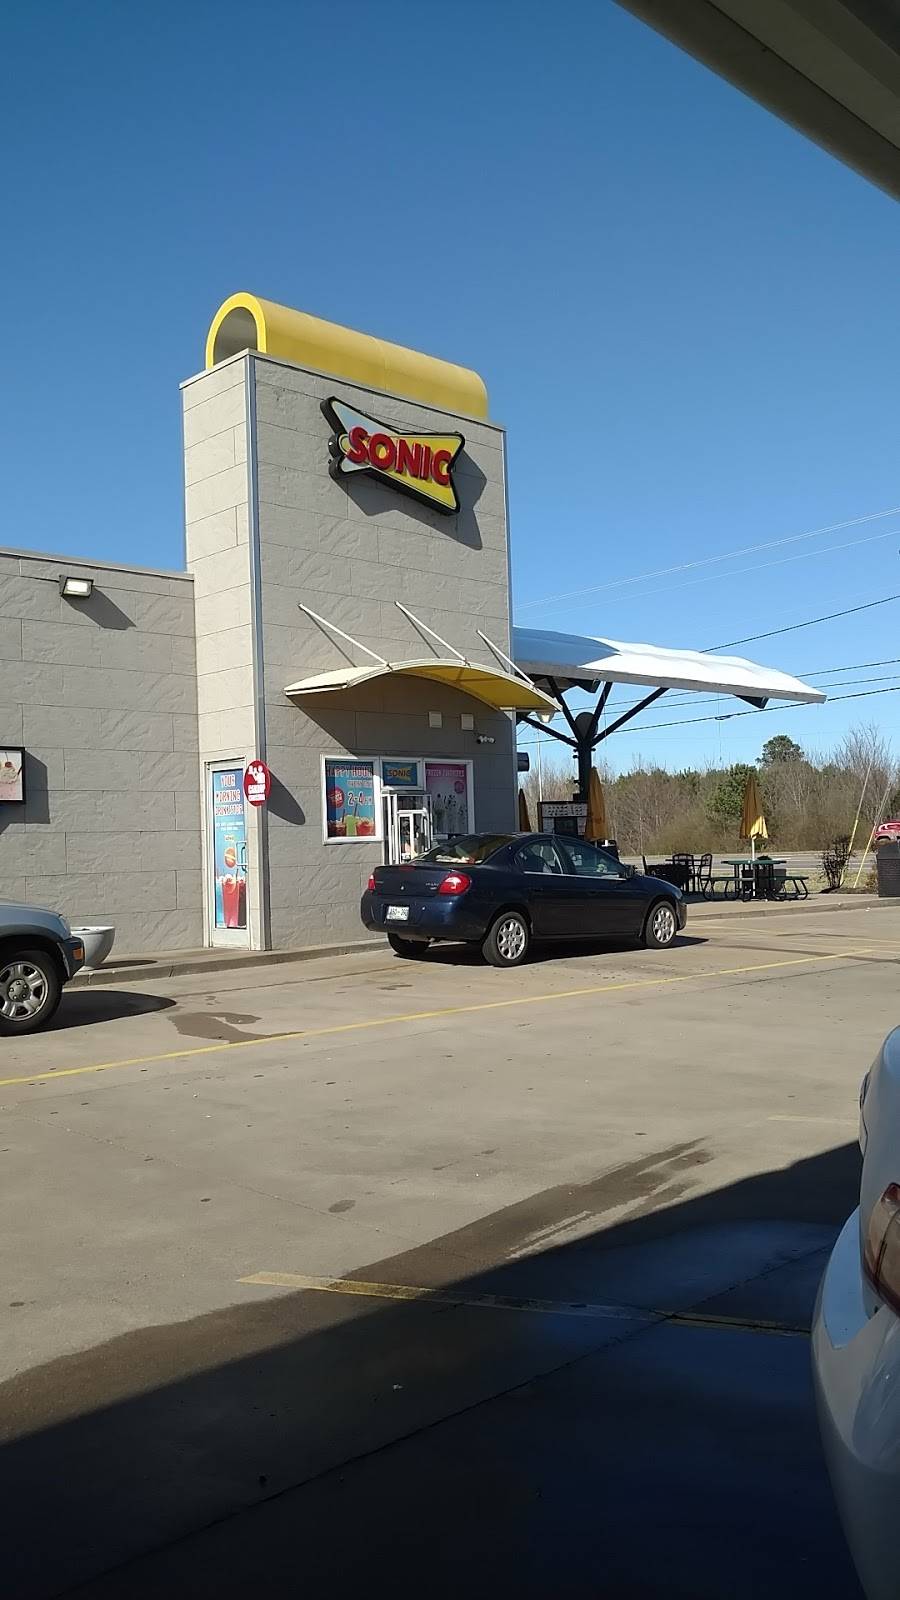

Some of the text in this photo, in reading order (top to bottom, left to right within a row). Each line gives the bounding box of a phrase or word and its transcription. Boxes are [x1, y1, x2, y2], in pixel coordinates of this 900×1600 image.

[345, 425, 454, 487] SONIC
[387, 768, 411, 777] SONIC
[220, 774, 236, 787] YOUR
[216, 789, 241, 802] MORNING
